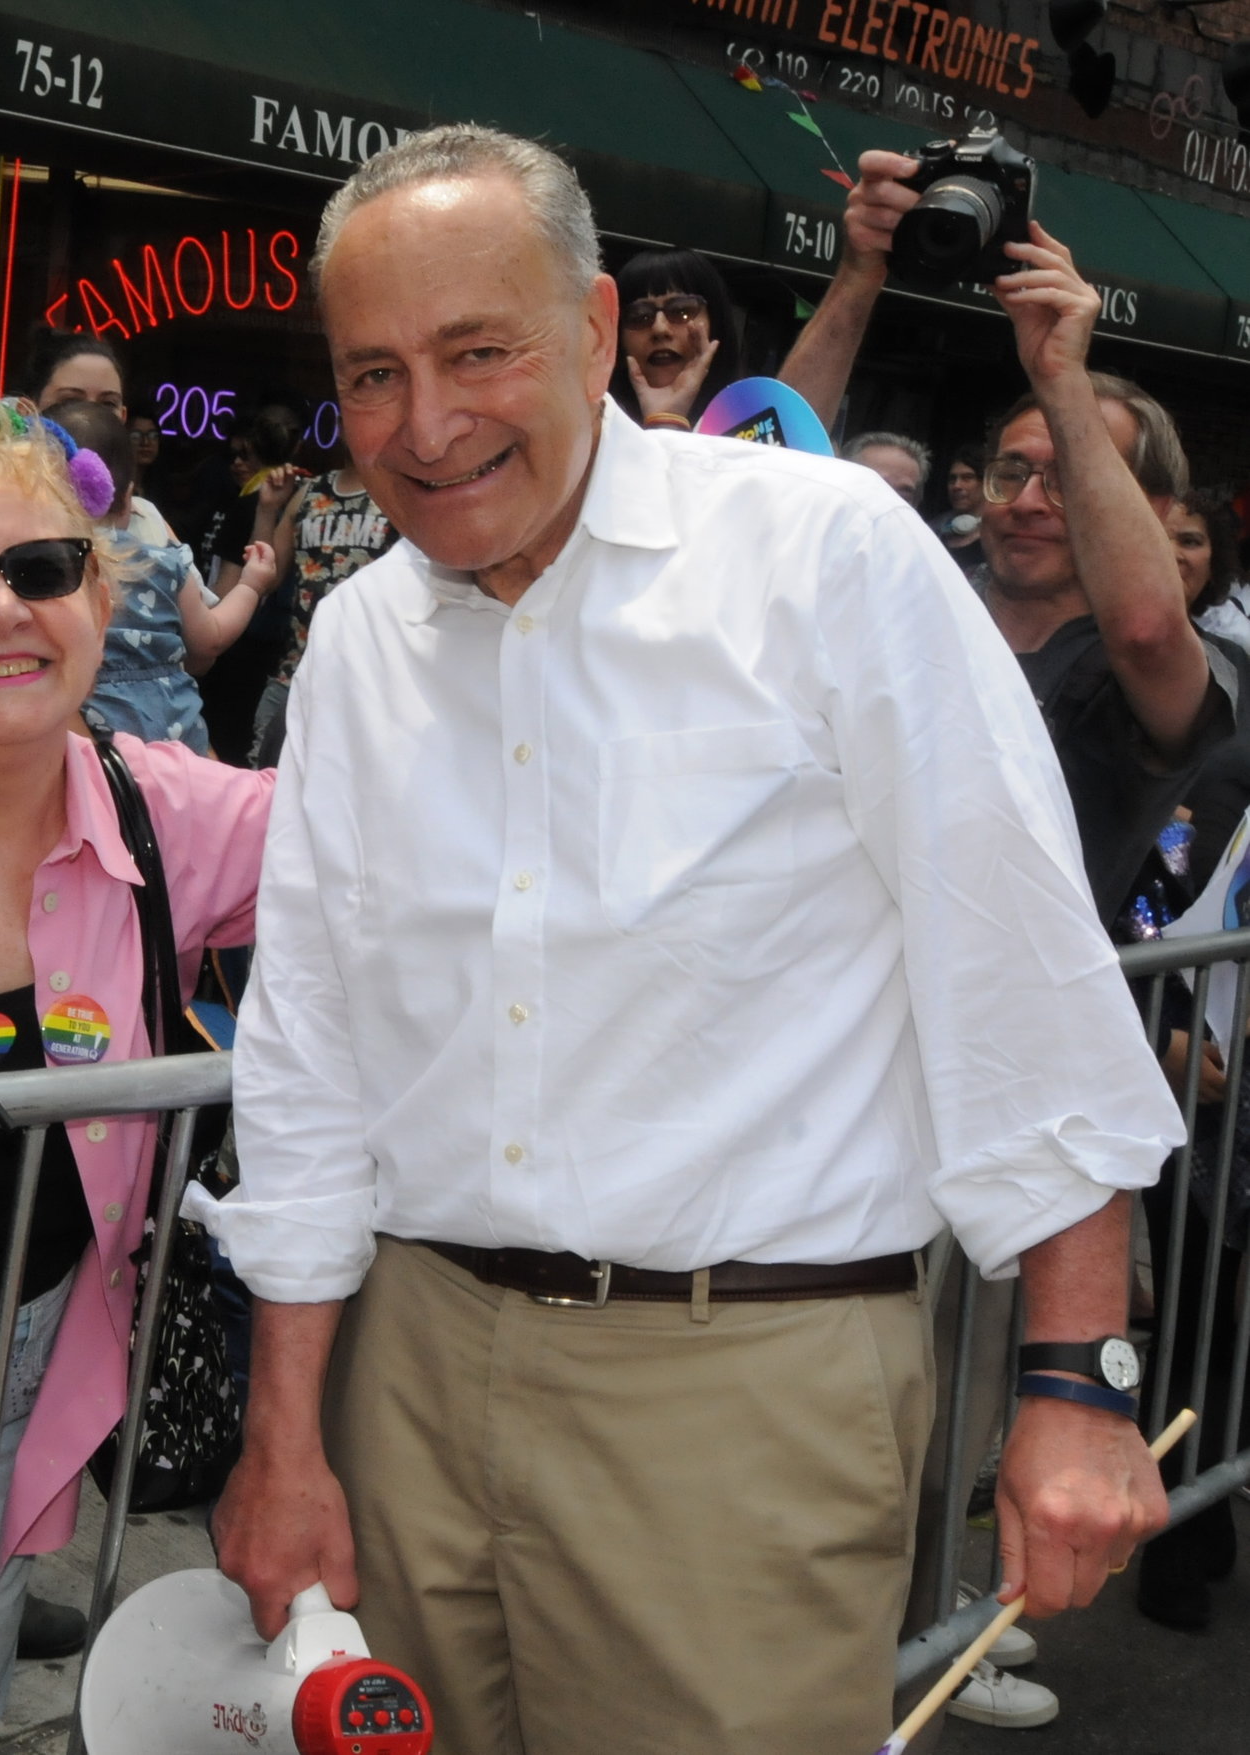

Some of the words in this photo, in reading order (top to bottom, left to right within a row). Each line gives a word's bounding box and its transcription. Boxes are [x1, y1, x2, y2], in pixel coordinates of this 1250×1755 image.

[16, 39, 104, 109] 75-12
[818, 0, 1039, 99] ELECTRONICS
[775, 51, 809, 81] 110
[839, 68, 880, 99] 220
[895, 84, 956, 119] VOLTS
[954, 154, 983, 163] Canon
[1183, 129, 1250, 193] OLIVO
[785, 213, 835, 261] 75-10
[45, 229, 299, 340] FAMOUS
[156, 383, 236, 440] 205
[301, 513, 388, 549] MIAMI
[69, 1020, 77, 1030] TO
[78, 1021, 91, 1032] YOU
[73, 1034, 82, 1043] AT
